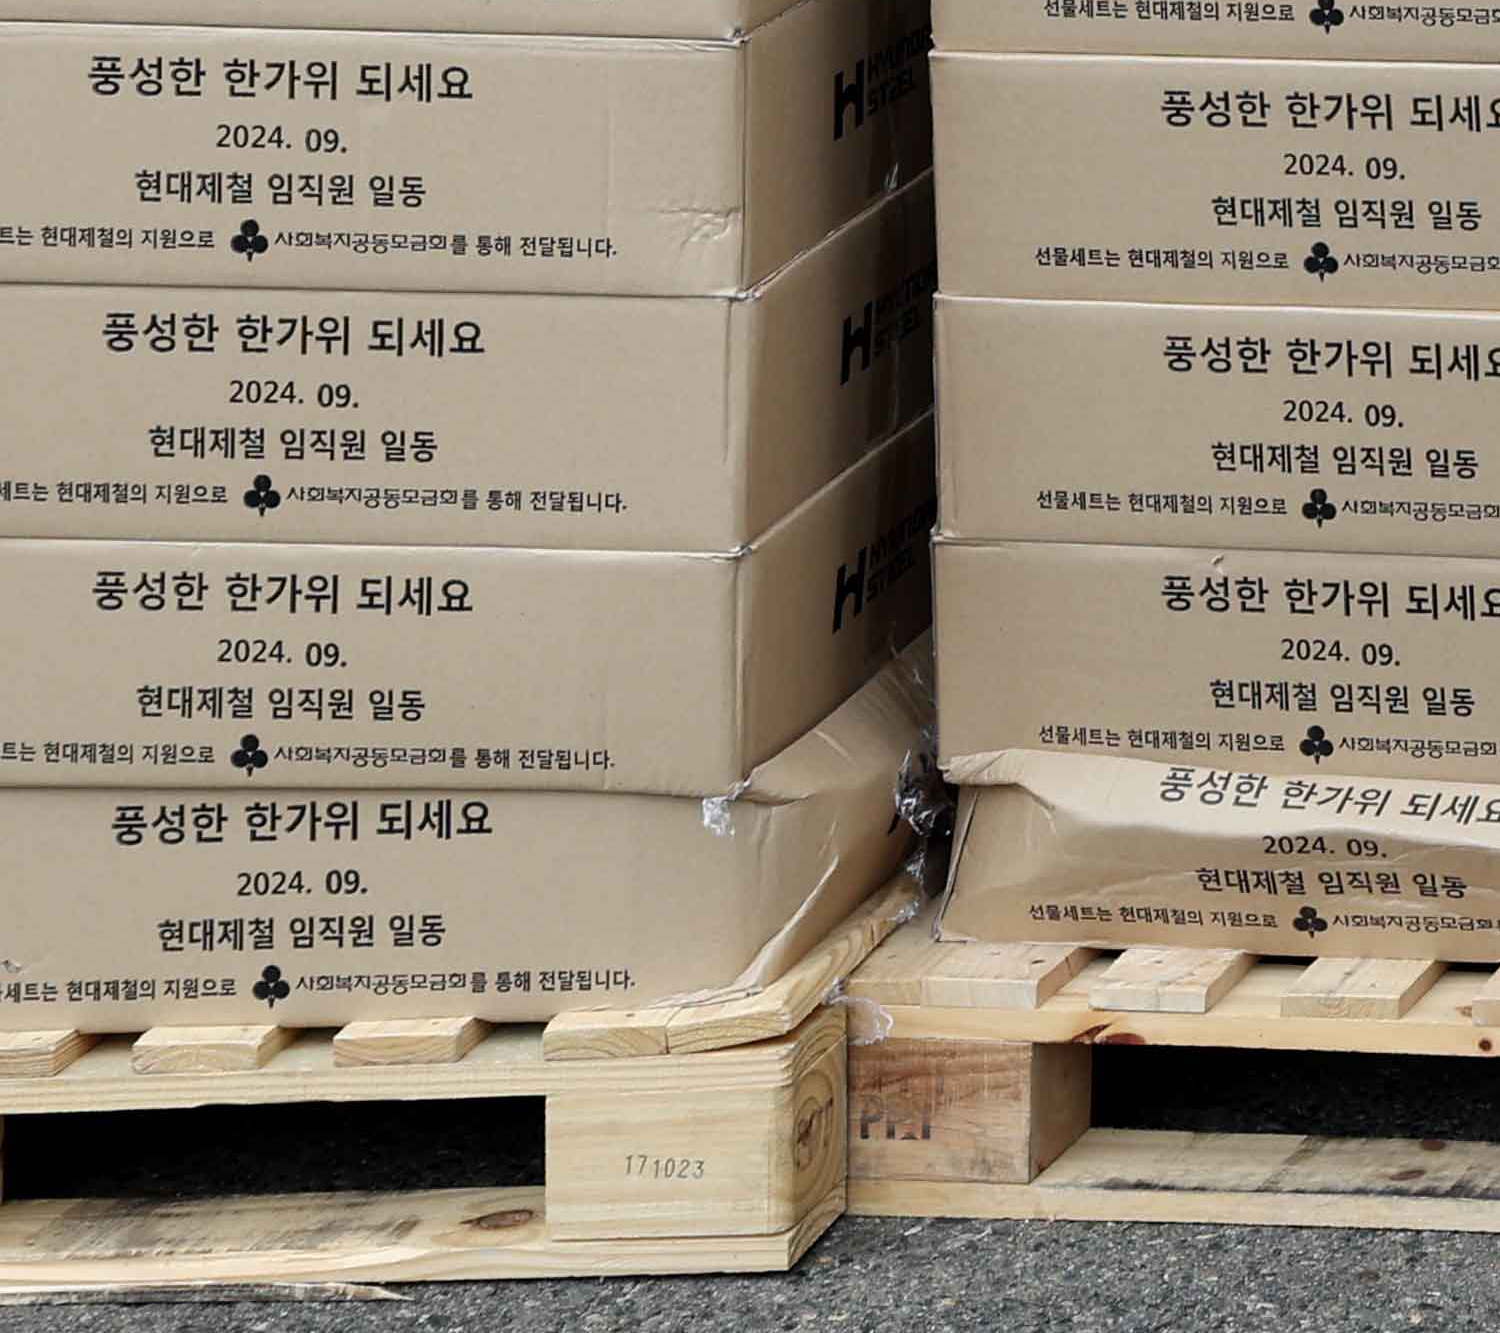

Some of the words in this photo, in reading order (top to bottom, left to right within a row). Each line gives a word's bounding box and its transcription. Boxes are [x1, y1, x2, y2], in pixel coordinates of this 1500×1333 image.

[1134, 0, 1220, 22] 현대제철의
[1226, 1, 1296, 22] 지원으로
[624, 1153, 705, 1180] 171023
